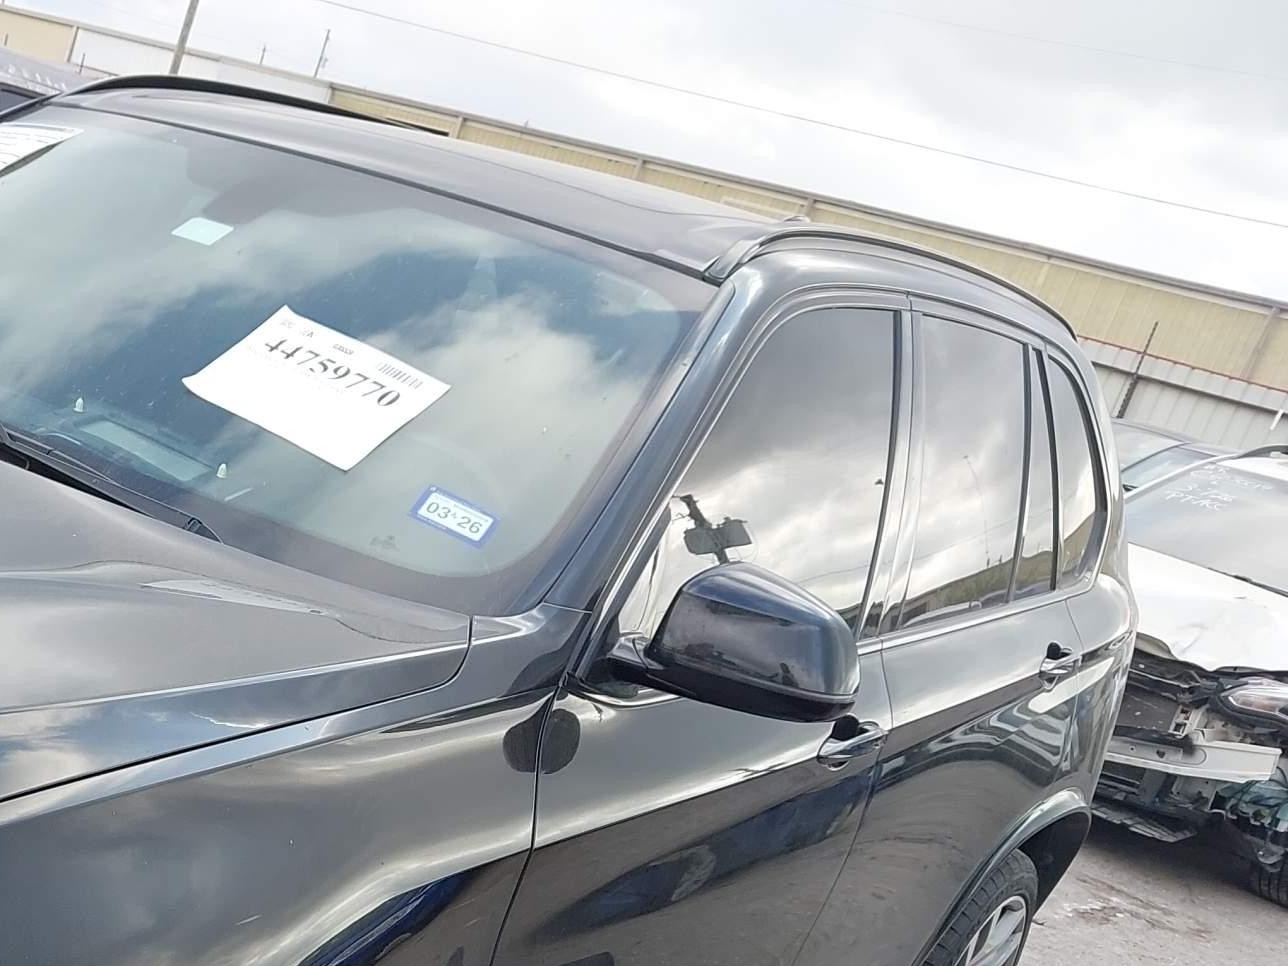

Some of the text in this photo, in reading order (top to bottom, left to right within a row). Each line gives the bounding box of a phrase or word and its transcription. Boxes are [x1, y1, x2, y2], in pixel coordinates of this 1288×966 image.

[264, 338, 401, 407] 44759770
[426, 501, 483, 534] 03 26
